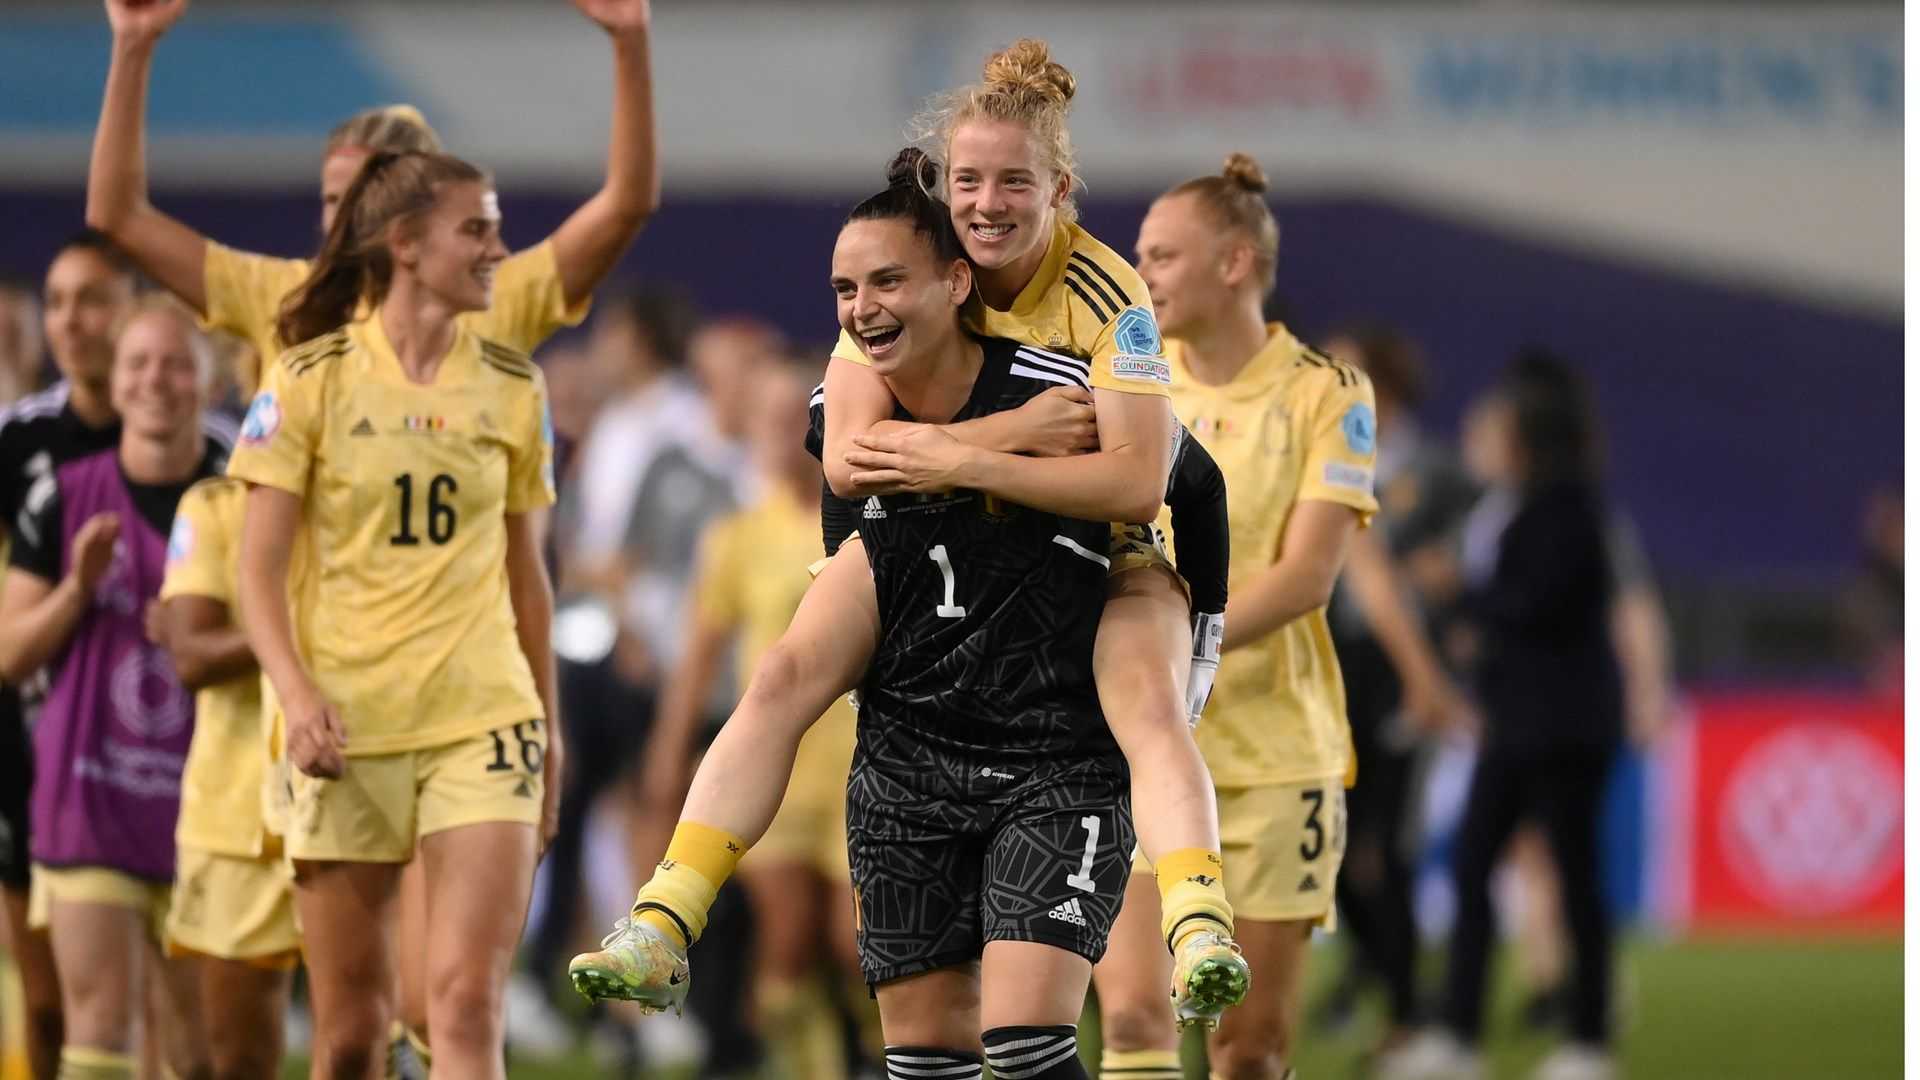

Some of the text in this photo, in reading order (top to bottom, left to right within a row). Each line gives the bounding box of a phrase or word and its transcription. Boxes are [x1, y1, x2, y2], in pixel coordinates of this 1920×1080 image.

[1113, 362, 1170, 376] FOUNDATION
[390, 473, 458, 546] 16
[863, 509, 887, 519] adidas
[928, 544, 966, 617] 1
[486, 718, 544, 775] 16
[1066, 815, 1100, 894] 1
[1300, 789, 1325, 861] 3
[1048, 910, 1087, 927] adidas
